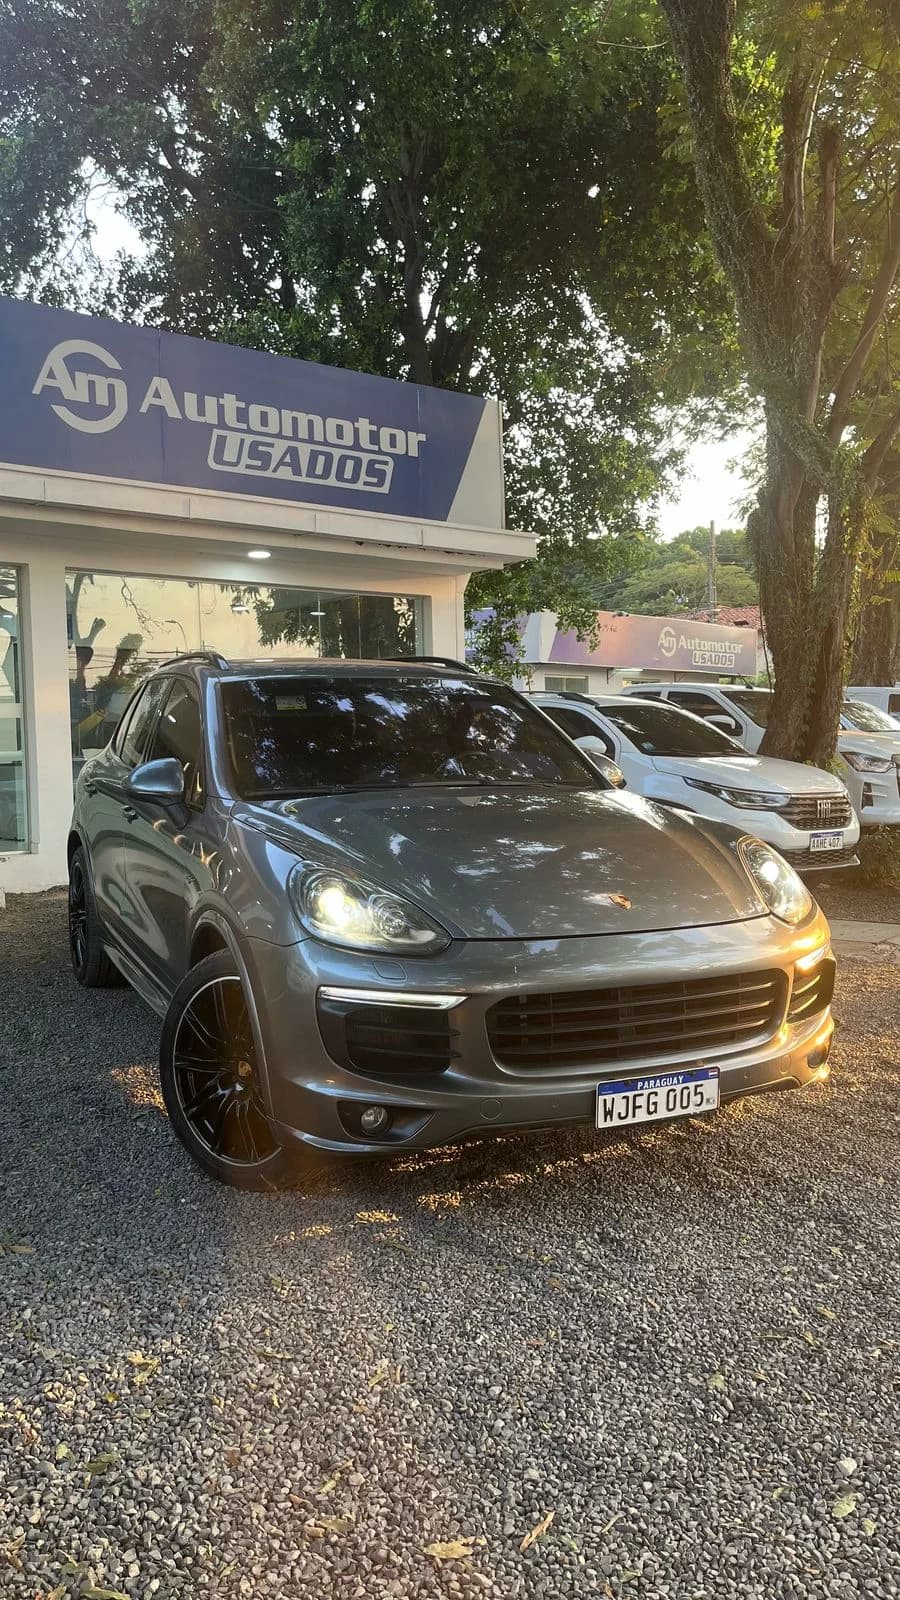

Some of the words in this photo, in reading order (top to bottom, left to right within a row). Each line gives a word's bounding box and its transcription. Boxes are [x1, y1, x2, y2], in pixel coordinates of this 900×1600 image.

[139, 376, 427, 457] Automotor
[212, 434, 391, 489] USADOS
[678, 635, 744, 653] Automotor
[693, 652, 734, 666] USADOS
[637, 1075, 684, 1090] PARAGUAY
[603, 1091, 659, 1123] WJFG
[665, 1083, 704, 1112] 005
